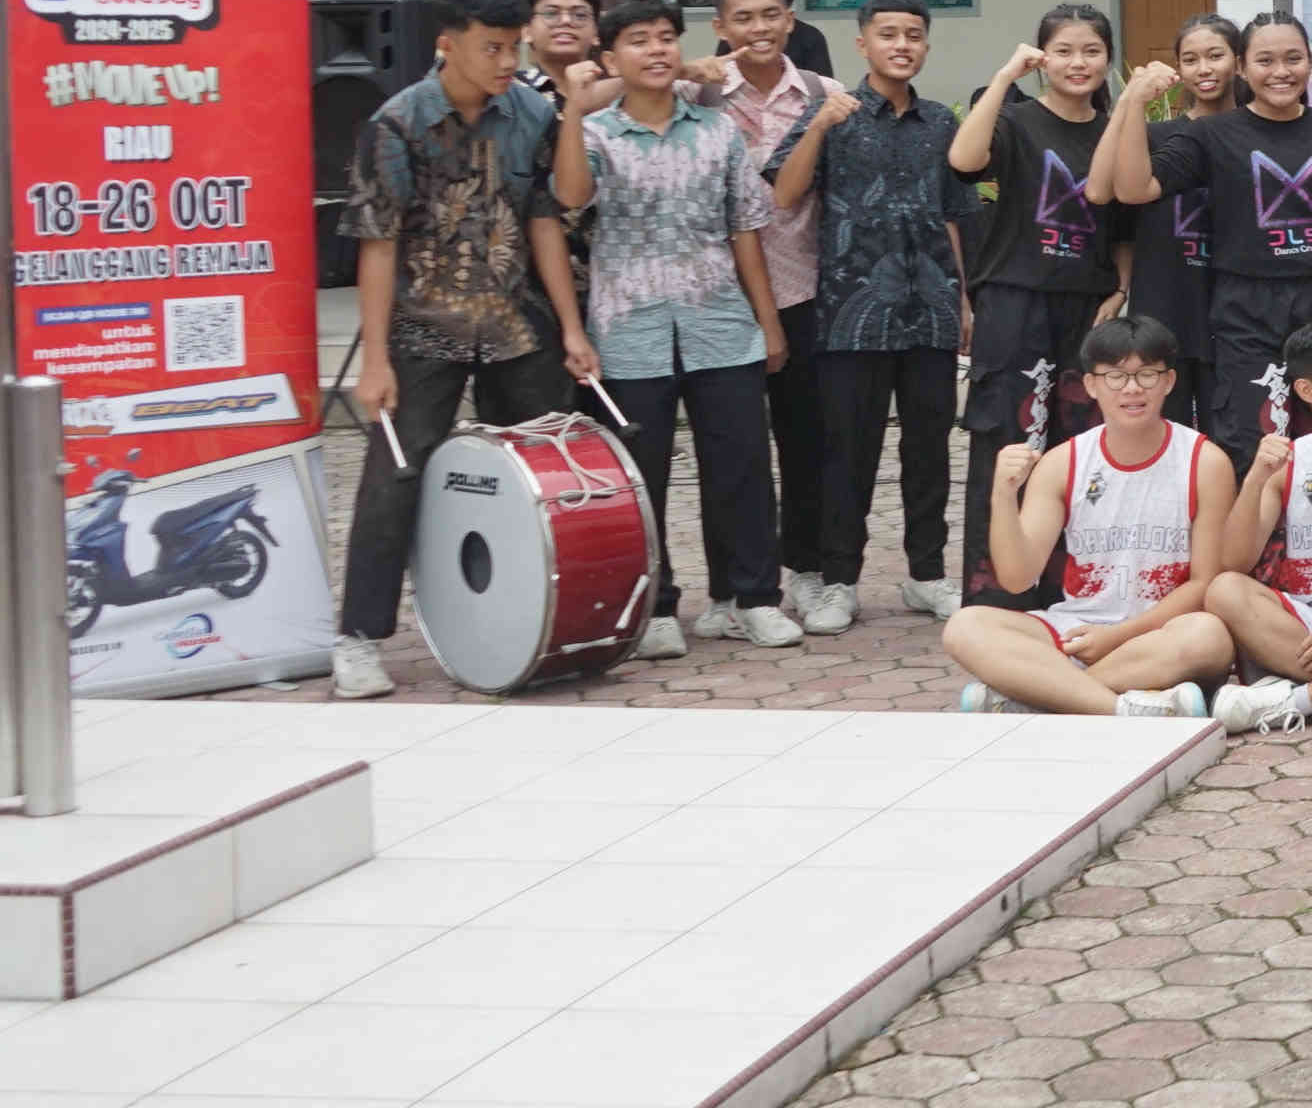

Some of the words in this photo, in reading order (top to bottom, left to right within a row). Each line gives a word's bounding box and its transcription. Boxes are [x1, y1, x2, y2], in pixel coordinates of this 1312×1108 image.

[103, 125, 173, 161] RIAU
[26, 180, 157, 236] 18-26
[171, 176, 252, 230] OCT
[14, 245, 170, 286] GELANGGANG
[174, 241, 275, 277] REMAJA
[101, 324, 156, 339] untuk
